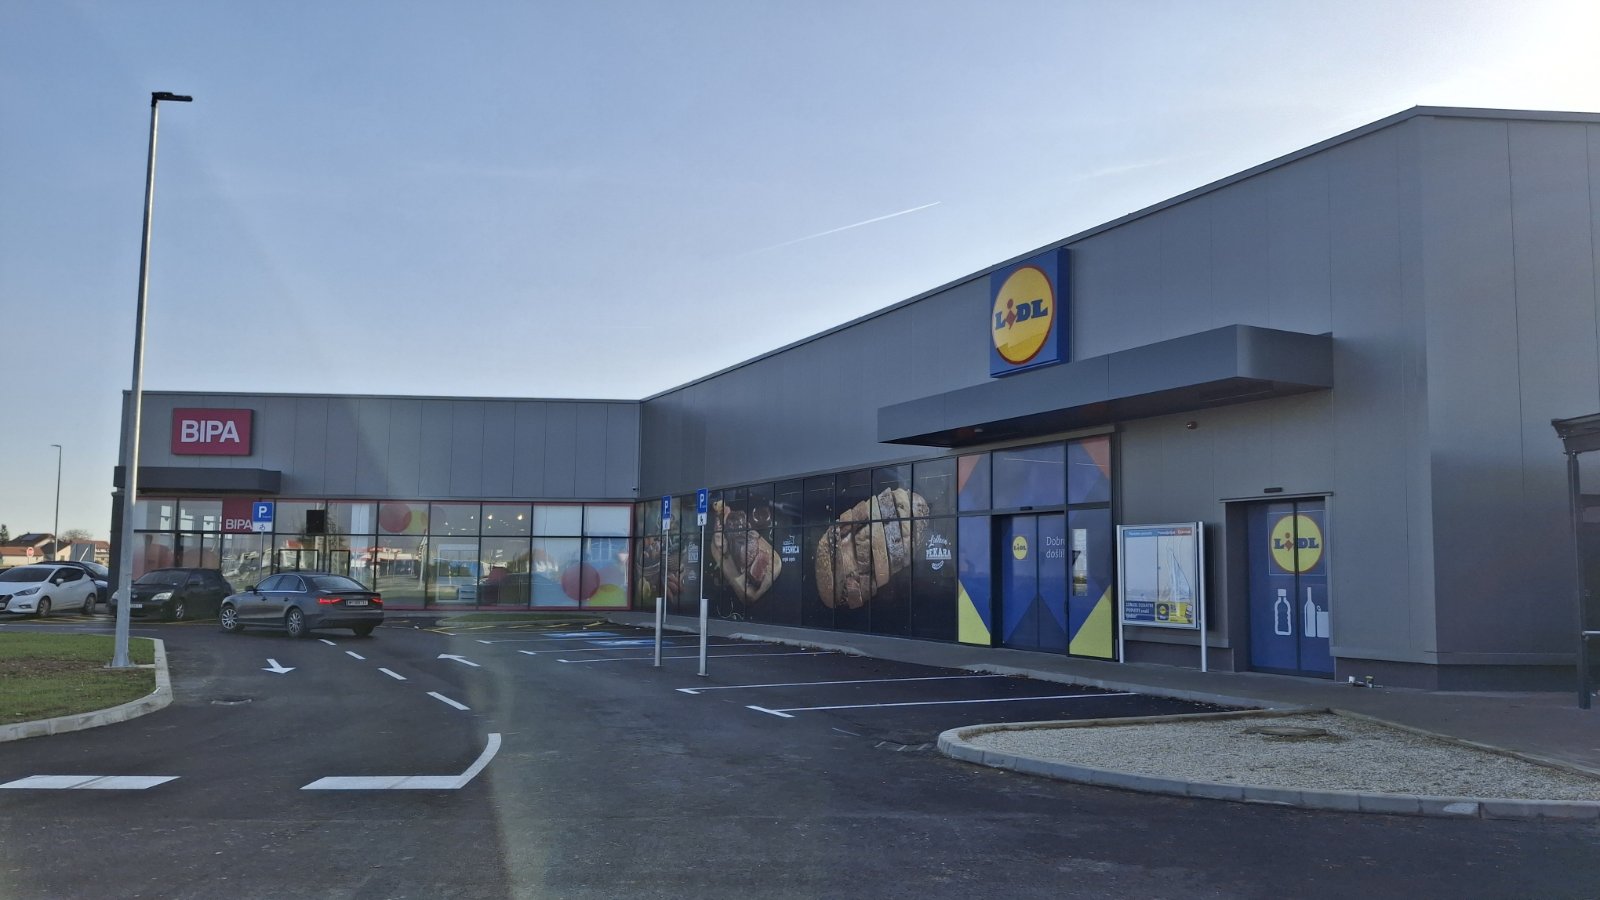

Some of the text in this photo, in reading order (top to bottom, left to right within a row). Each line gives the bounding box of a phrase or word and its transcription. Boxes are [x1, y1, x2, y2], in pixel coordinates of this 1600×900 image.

[181, 419, 240, 443] BIPA
[700, 493, 705, 509] P
[258, 506, 268, 518] P
[225, 518, 253, 530] BIPA
[926, 547, 952, 559] PEKARA
